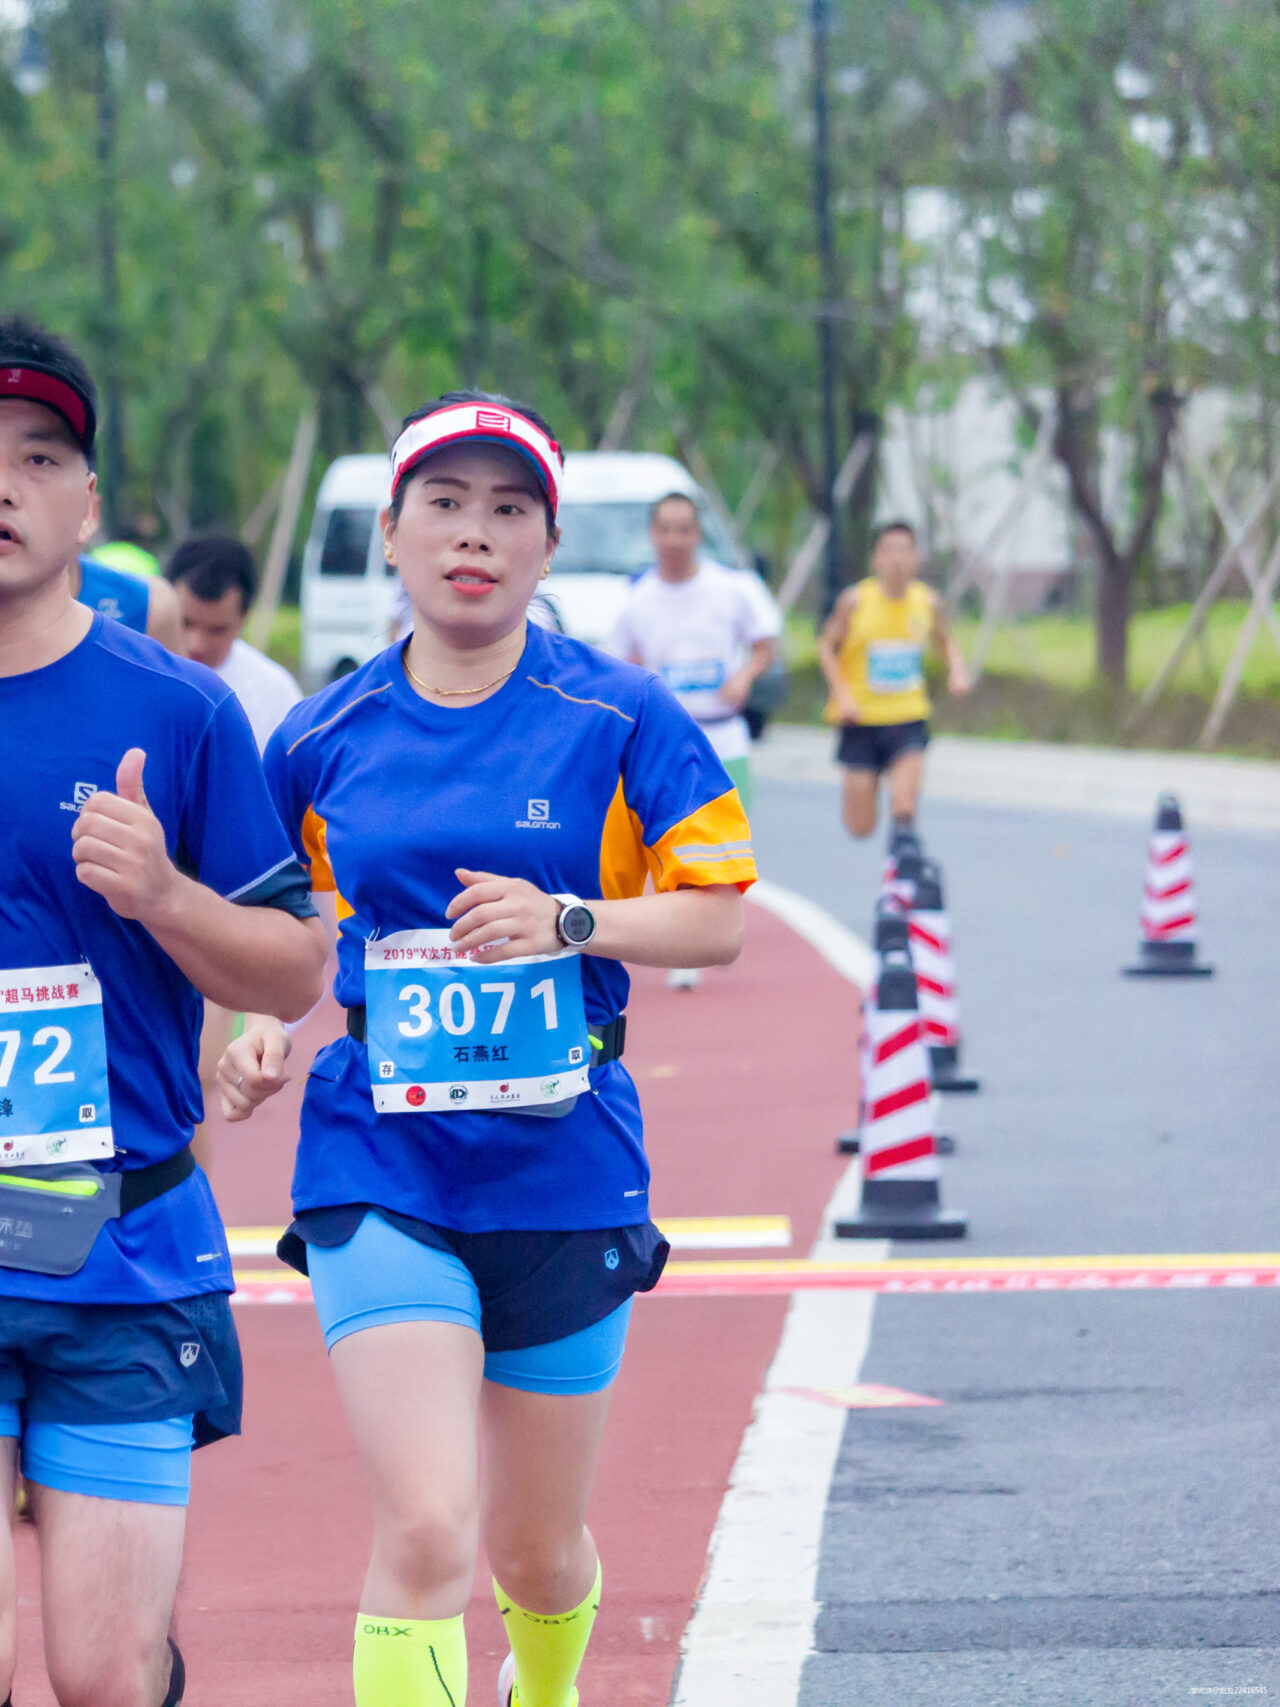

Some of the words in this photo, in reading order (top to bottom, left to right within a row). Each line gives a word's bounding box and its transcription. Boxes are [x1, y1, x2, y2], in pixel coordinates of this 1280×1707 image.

[397, 978, 559, 1038] 3071
[453, 1044, 510, 1063] 石燕红
[381, 1064, 393, 1076] 存
[81, 1106, 93, 1119] 取
[363, 1624, 413, 1637] OBX
